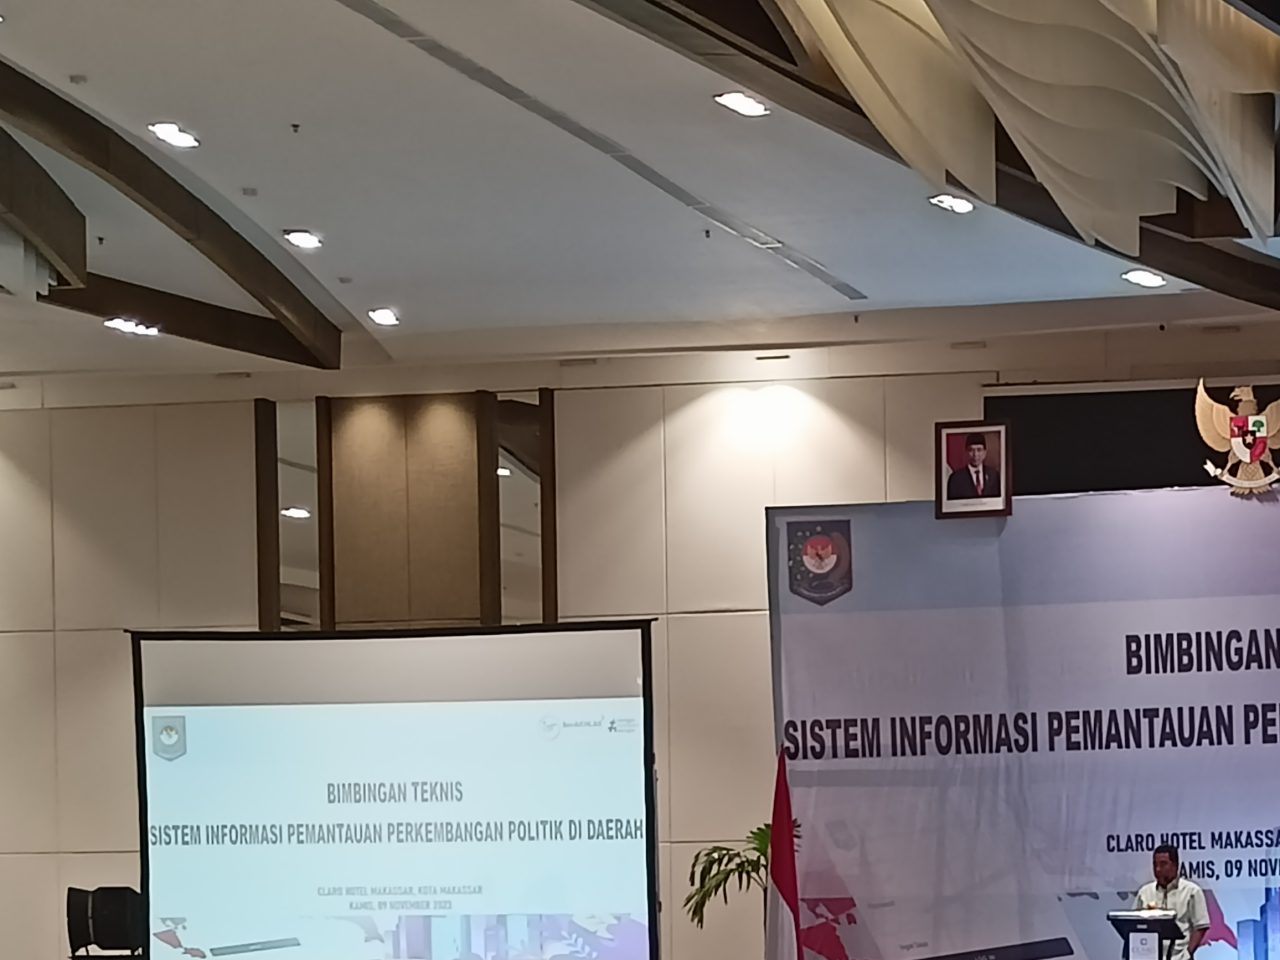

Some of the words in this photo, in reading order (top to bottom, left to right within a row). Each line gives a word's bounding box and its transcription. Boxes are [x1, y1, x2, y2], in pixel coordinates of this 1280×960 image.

[783, 717, 882, 761] SISTEM
[891, 711, 1038, 758] INFORMASI
[1048, 704, 1234, 752] PEMANTAUAN
[327, 782, 407, 804] BIMBINGAN
[411, 781, 463, 802] TEKNIS
[150, 824, 201, 846] SISTEM
[206, 823, 283, 845] INFORMASI
[287, 823, 382, 845] PEMANTAUAN
[387, 821, 503, 843] PERKEMBANGAN
[508, 820, 564, 841] POLITIK
[568, 819, 582, 841] DI
[587, 818, 644, 840] DAERAH
[1106, 833, 1155, 852] CLARO
[1160, 832, 1206, 850] HOTEL
[1179, 860, 1220, 881] AMIS,
[1224, 859, 1243, 878] 09
